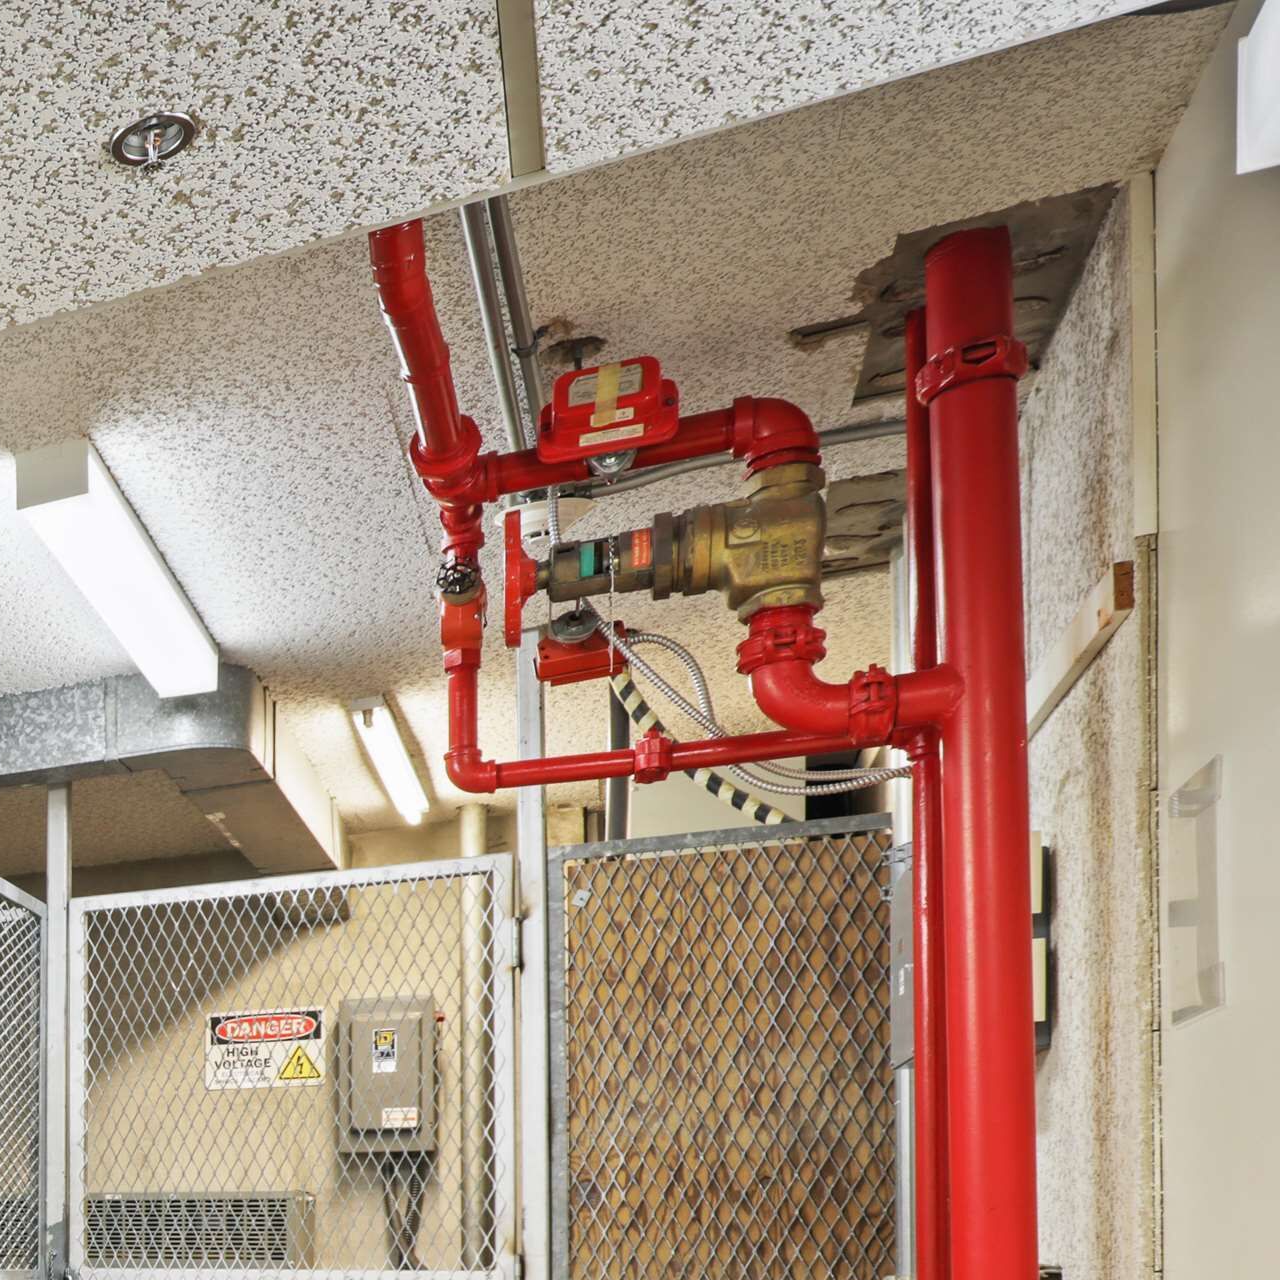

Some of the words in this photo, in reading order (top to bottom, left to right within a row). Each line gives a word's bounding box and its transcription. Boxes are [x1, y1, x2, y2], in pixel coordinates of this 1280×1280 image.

[225, 1018, 306, 1038] DANGER
[226, 1046, 258, 1057] HIGH
[215, 1058, 271, 1070] VOLTAGE
